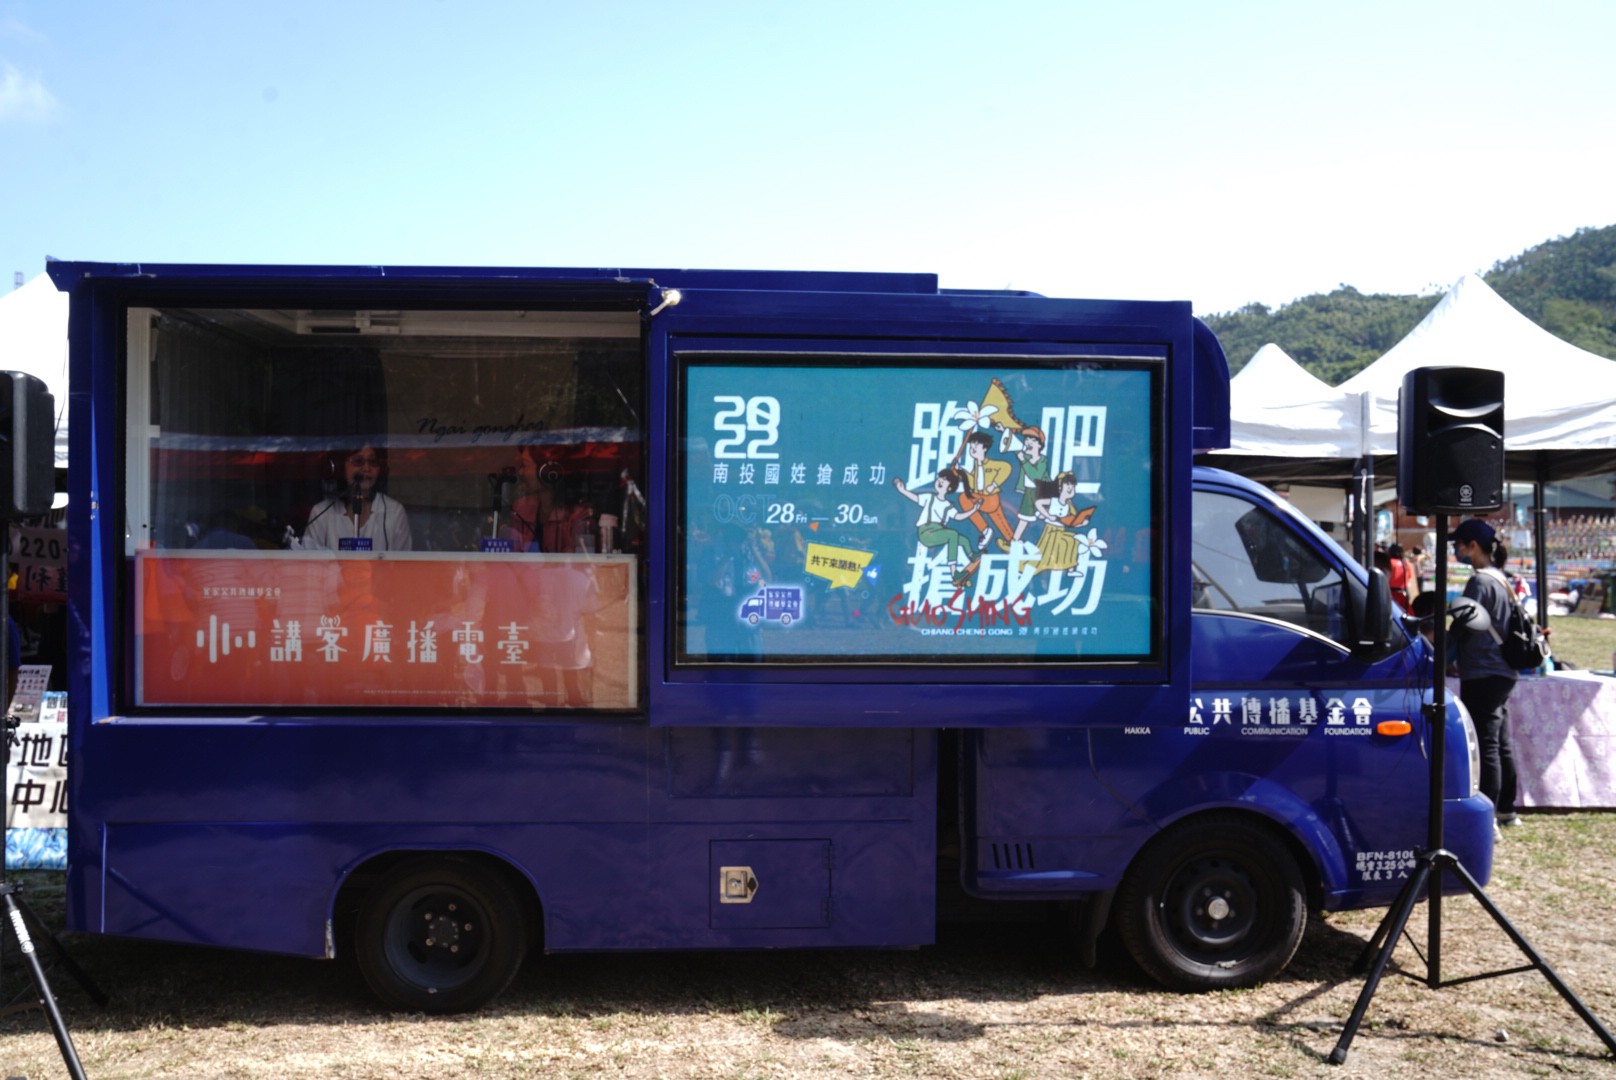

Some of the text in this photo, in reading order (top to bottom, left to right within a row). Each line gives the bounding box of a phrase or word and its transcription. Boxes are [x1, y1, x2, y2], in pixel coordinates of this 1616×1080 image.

[713, 462, 886, 485] 南投國姓搶成功
[903, 540, 1107, 617] 搶成功
[270, 615, 529, 664] 講客廣播電臺
[921, 628, 955, 636] CHIANG
[956, 628, 987, 636] CHENG
[988, 628, 1013, 636] GONG
[1189, 697, 1373, 725] 公共傳播基金會
[1124, 727, 1372, 736] HAKKA PUBLIC COMMUNICATION FOUNDATION
